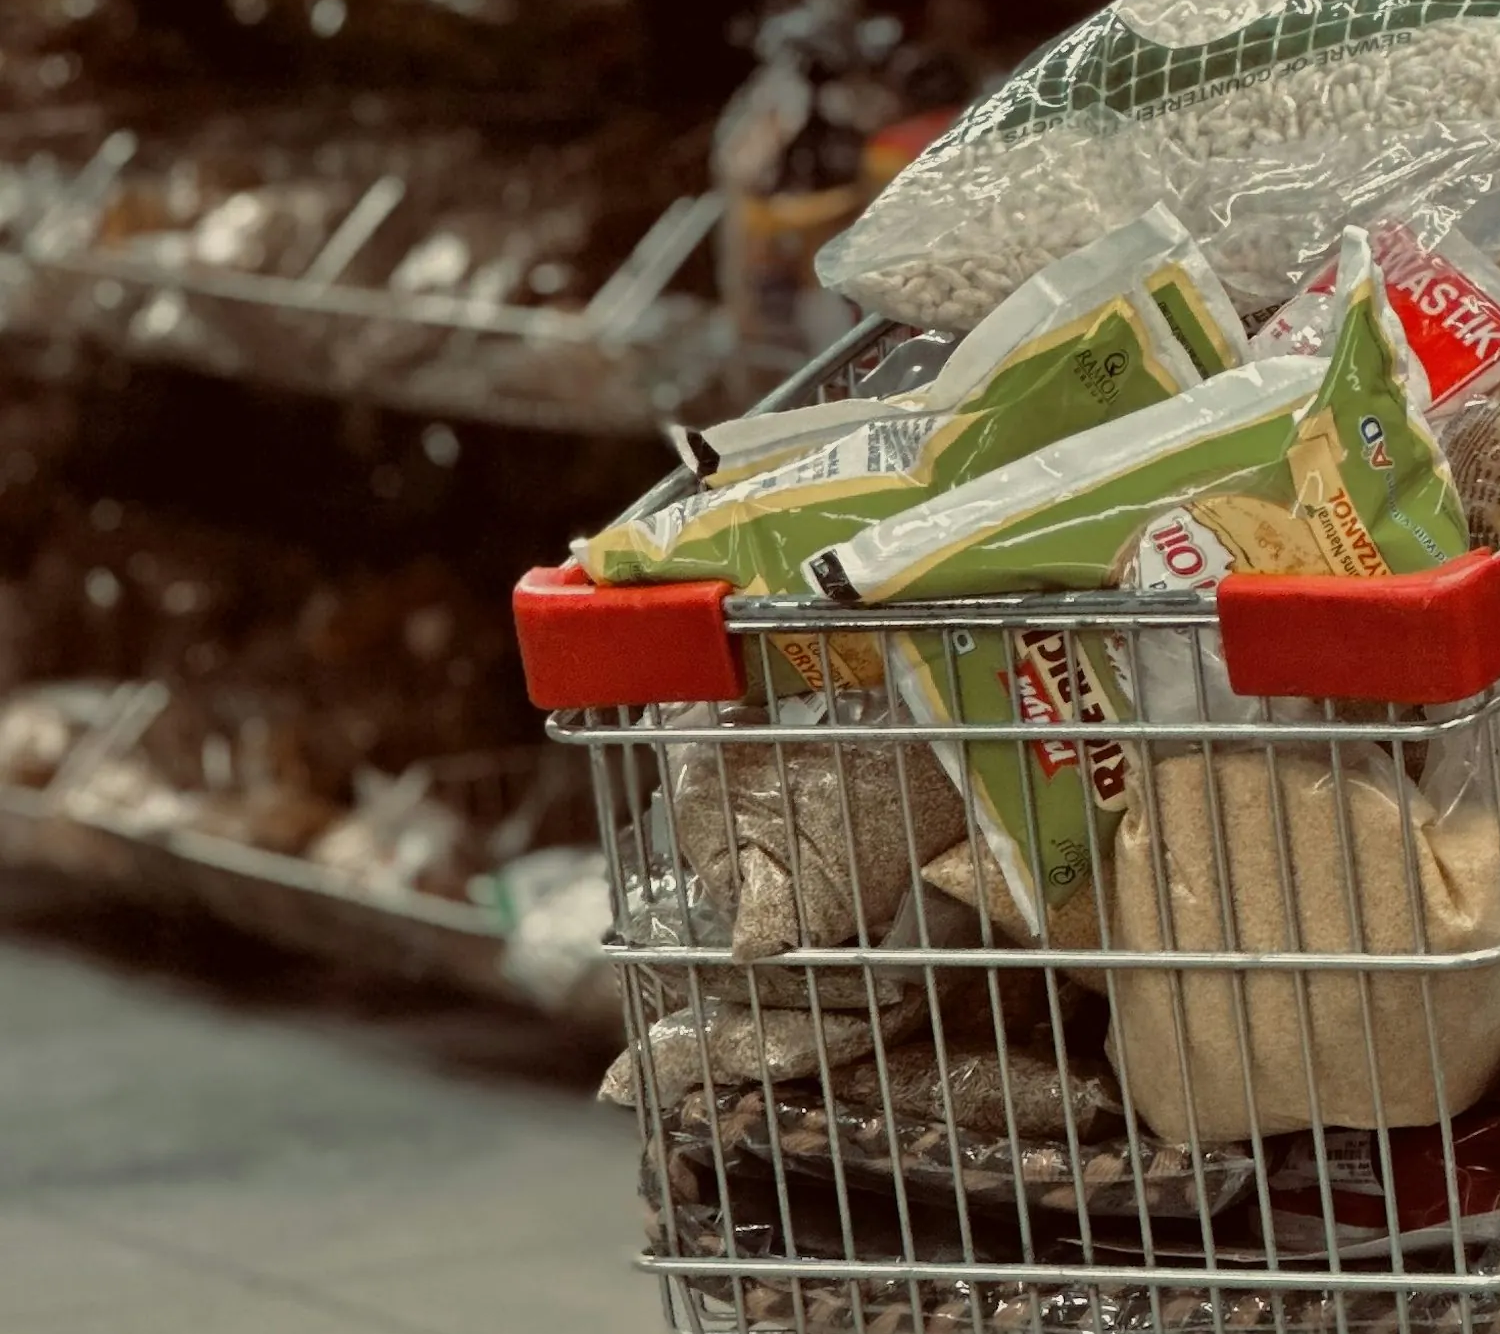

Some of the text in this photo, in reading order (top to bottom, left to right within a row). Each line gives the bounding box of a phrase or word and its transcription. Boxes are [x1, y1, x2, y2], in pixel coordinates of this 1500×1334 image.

[1150, 520, 1205, 576] Oil
[1315, 504, 1349, 558] Natural
[1328, 487, 1392, 576] YZANOL
